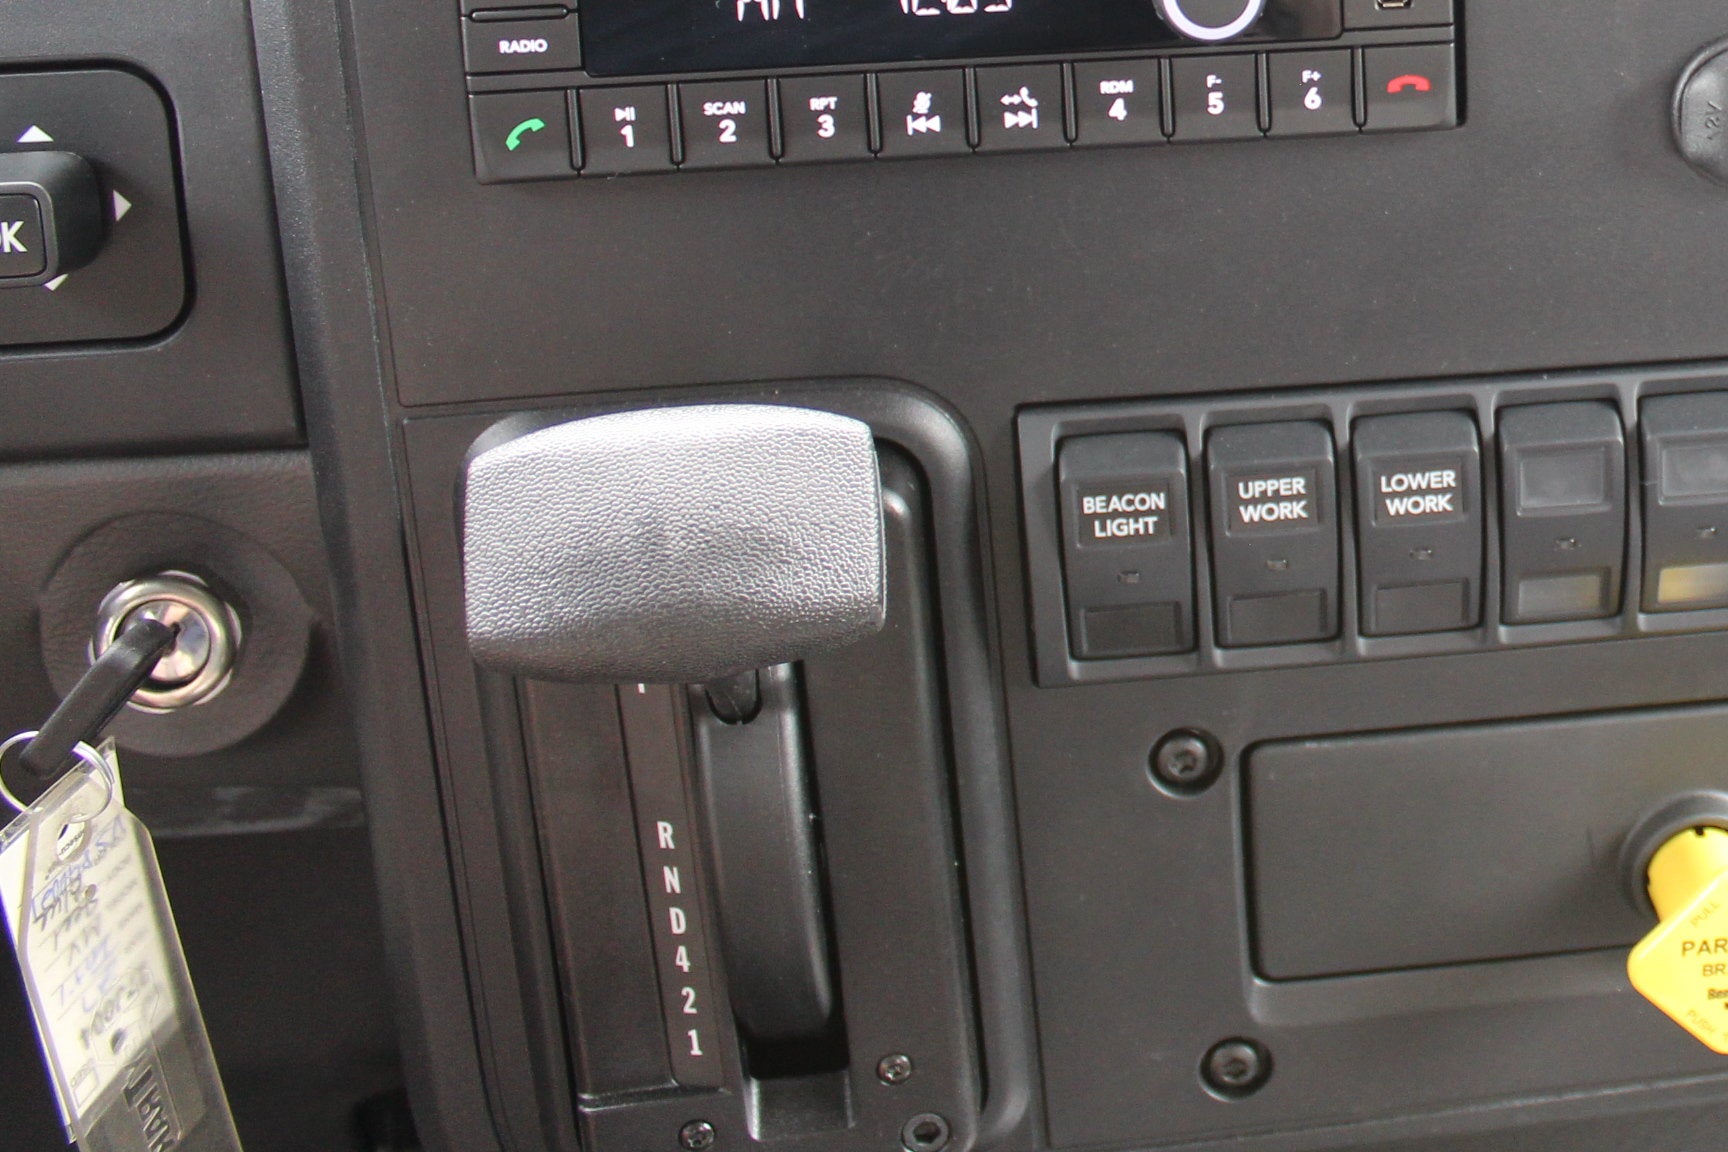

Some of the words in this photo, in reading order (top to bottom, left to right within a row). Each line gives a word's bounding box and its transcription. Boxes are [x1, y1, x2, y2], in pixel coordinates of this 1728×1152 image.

[499, 39, 547, 53] RADIO
[1100, 80, 1133, 94] RDM
[1304, 87, 1321, 109] 6
[704, 102, 745, 115] SCAN
[810, 97, 837, 110] RPT
[1109, 98, 1127, 120] 4
[1208, 92, 1224, 114] 5
[621, 125, 634, 147] 1
[719, 119, 736, 142] 2
[818, 115, 835, 137] 3
[0, 221, 27, 252] K
[1239, 477, 1305, 498] UPPER
[1381, 470, 1455, 492] LOWER
[1083, 493, 1165, 513] BEACON
[1240, 501, 1307, 522] WORK
[1386, 494, 1452, 515] WORK
[1095, 517, 1157, 537] LIGHT
[658, 822, 674, 849] R
[664, 866, 680, 893] N
[670, 908, 686, 934] D
[1689, 900, 1721, 928] PULL
[676, 946, 690, 972] 4
[682, 987, 697, 1013] 2
[1687, 1009, 1717, 1035] PUSH
[688, 1030, 702, 1055] 1
